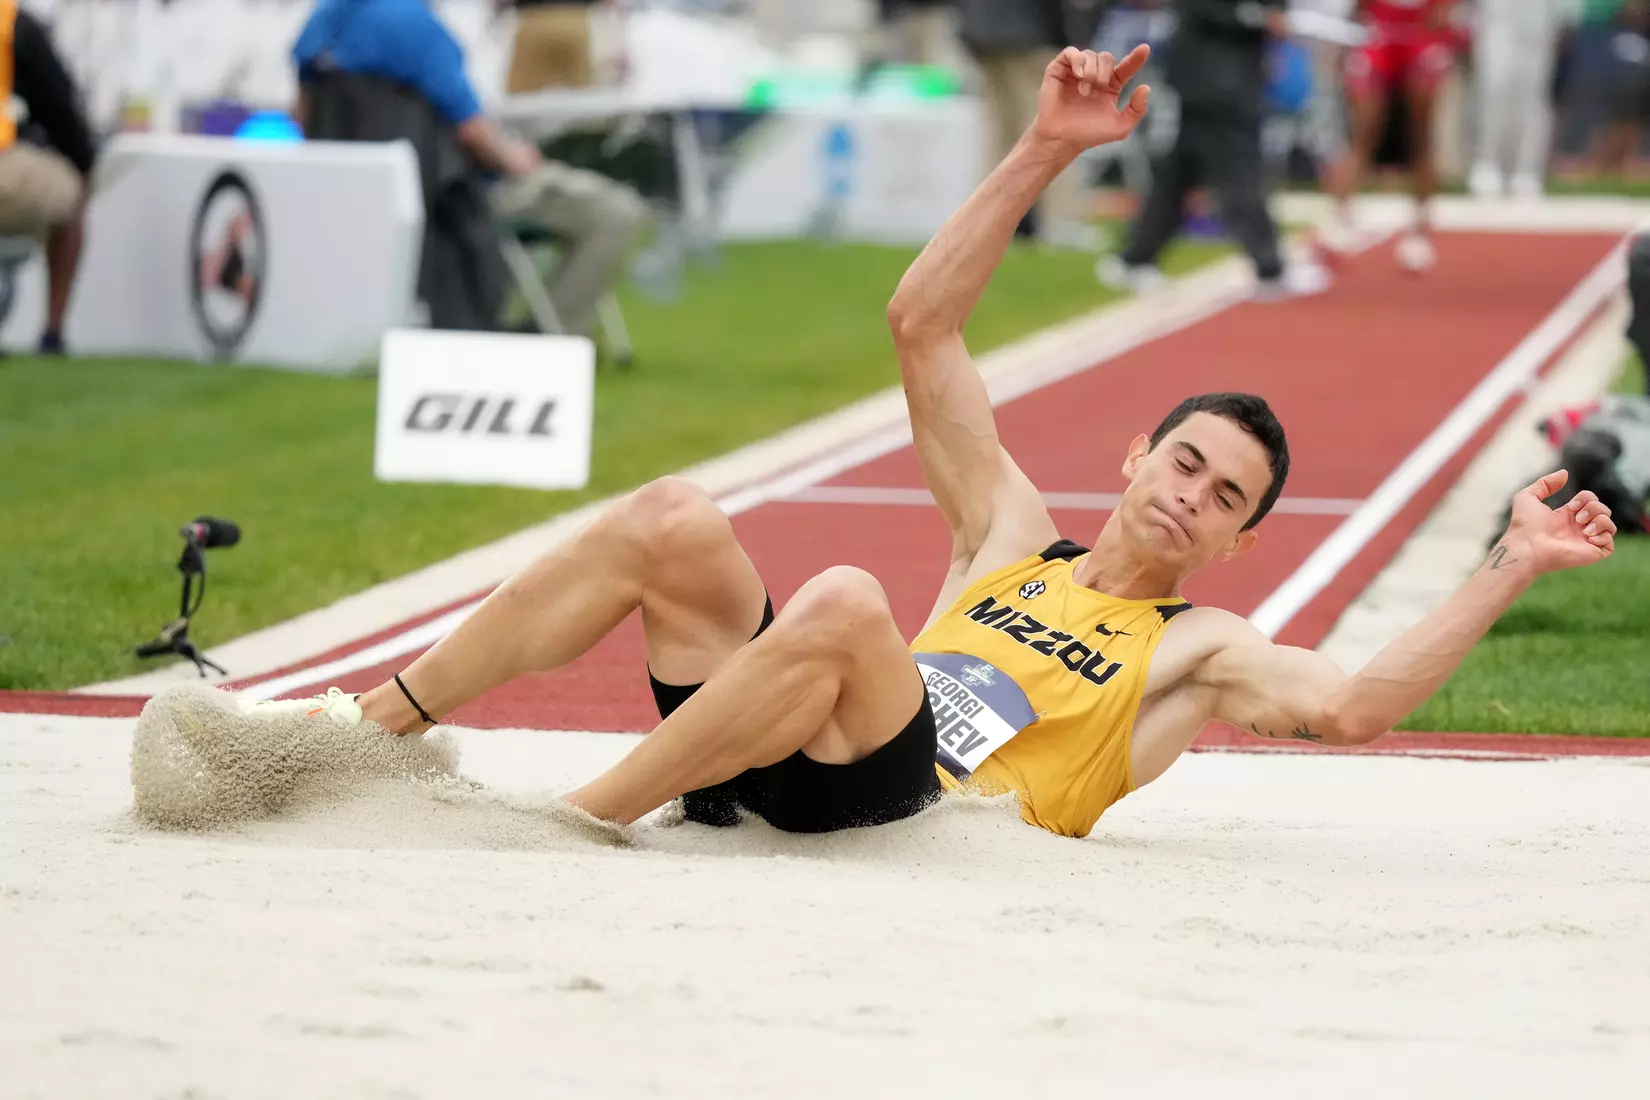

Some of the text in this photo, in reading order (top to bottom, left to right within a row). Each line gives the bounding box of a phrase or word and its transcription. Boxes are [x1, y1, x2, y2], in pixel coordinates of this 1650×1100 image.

[404, 393, 557, 435] GILL
[963, 595, 1124, 686] MIZZOU
[926, 671, 985, 720] GEORGI
